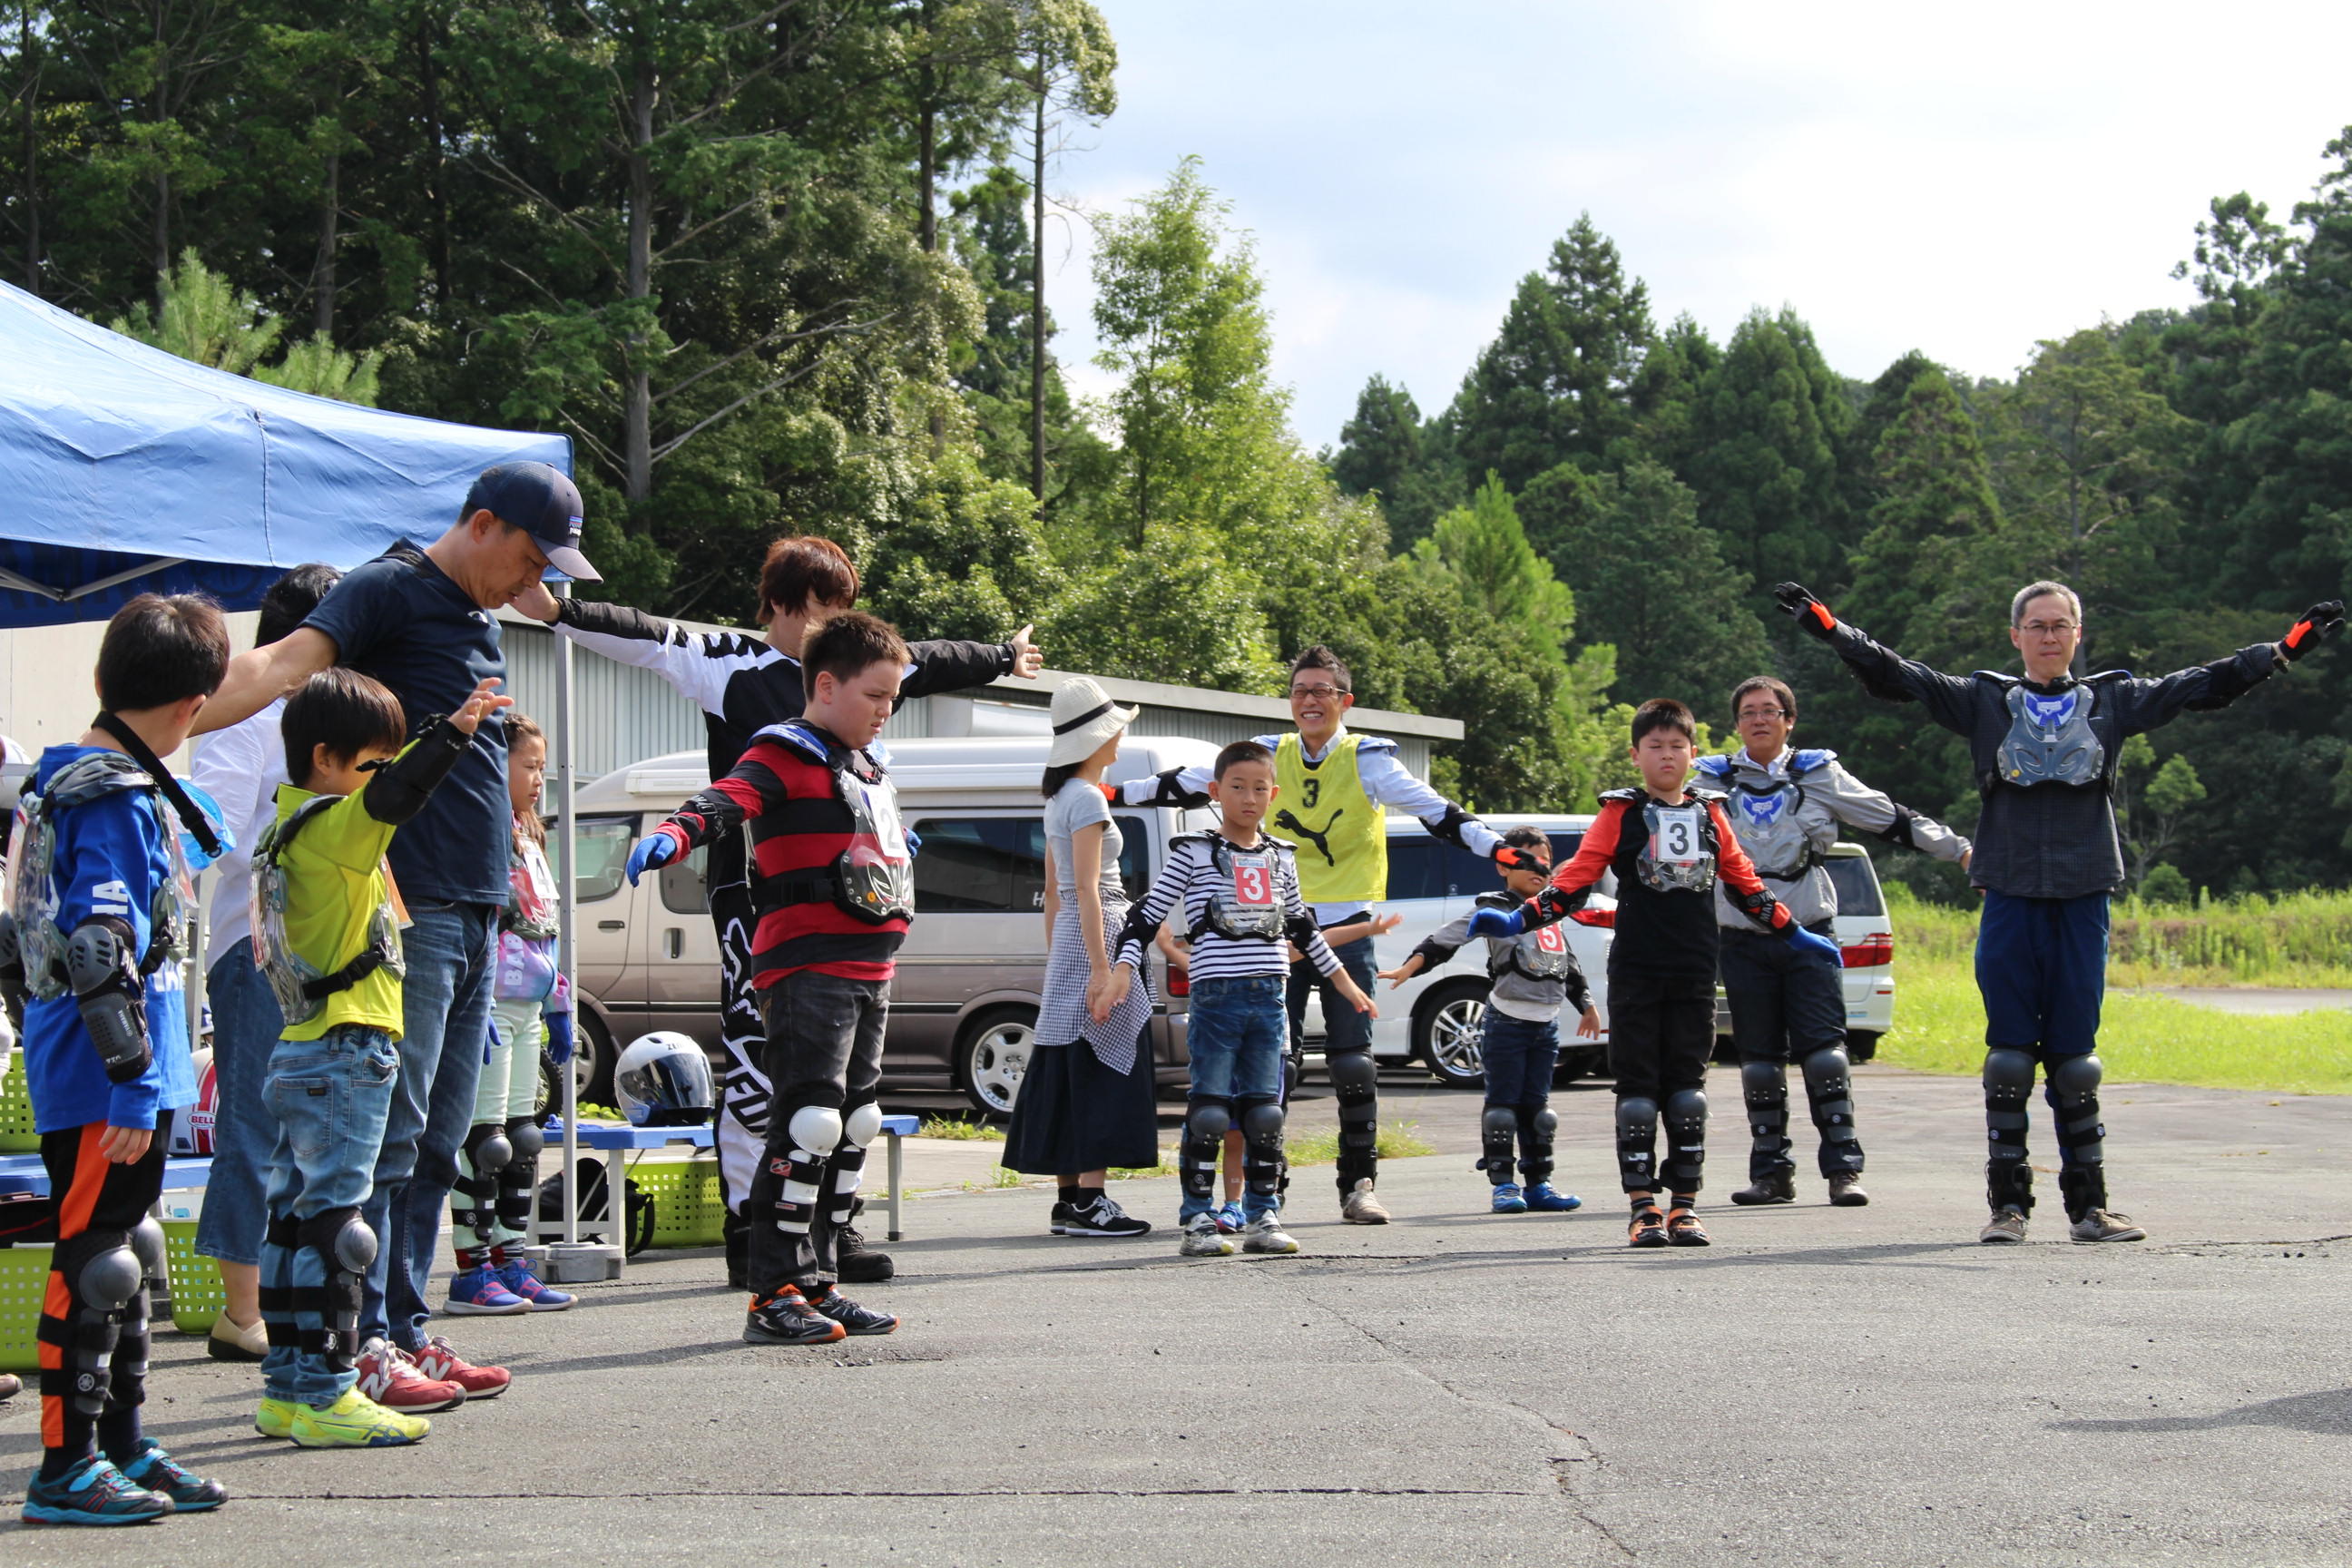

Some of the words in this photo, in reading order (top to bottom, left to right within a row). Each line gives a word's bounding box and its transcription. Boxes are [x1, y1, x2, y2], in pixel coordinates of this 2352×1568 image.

[1302, 778, 1320, 808] 3
[879, 807, 901, 849] 2
[1669, 822, 1690, 856] 3
[535, 857, 550, 894] 4
[1242, 867, 1264, 901] 3
[1542, 926, 1558, 949] 5
[191, 1115, 215, 1124] BELL
[418, 1356, 453, 1382] N
[358, 1372, 394, 1403] N
